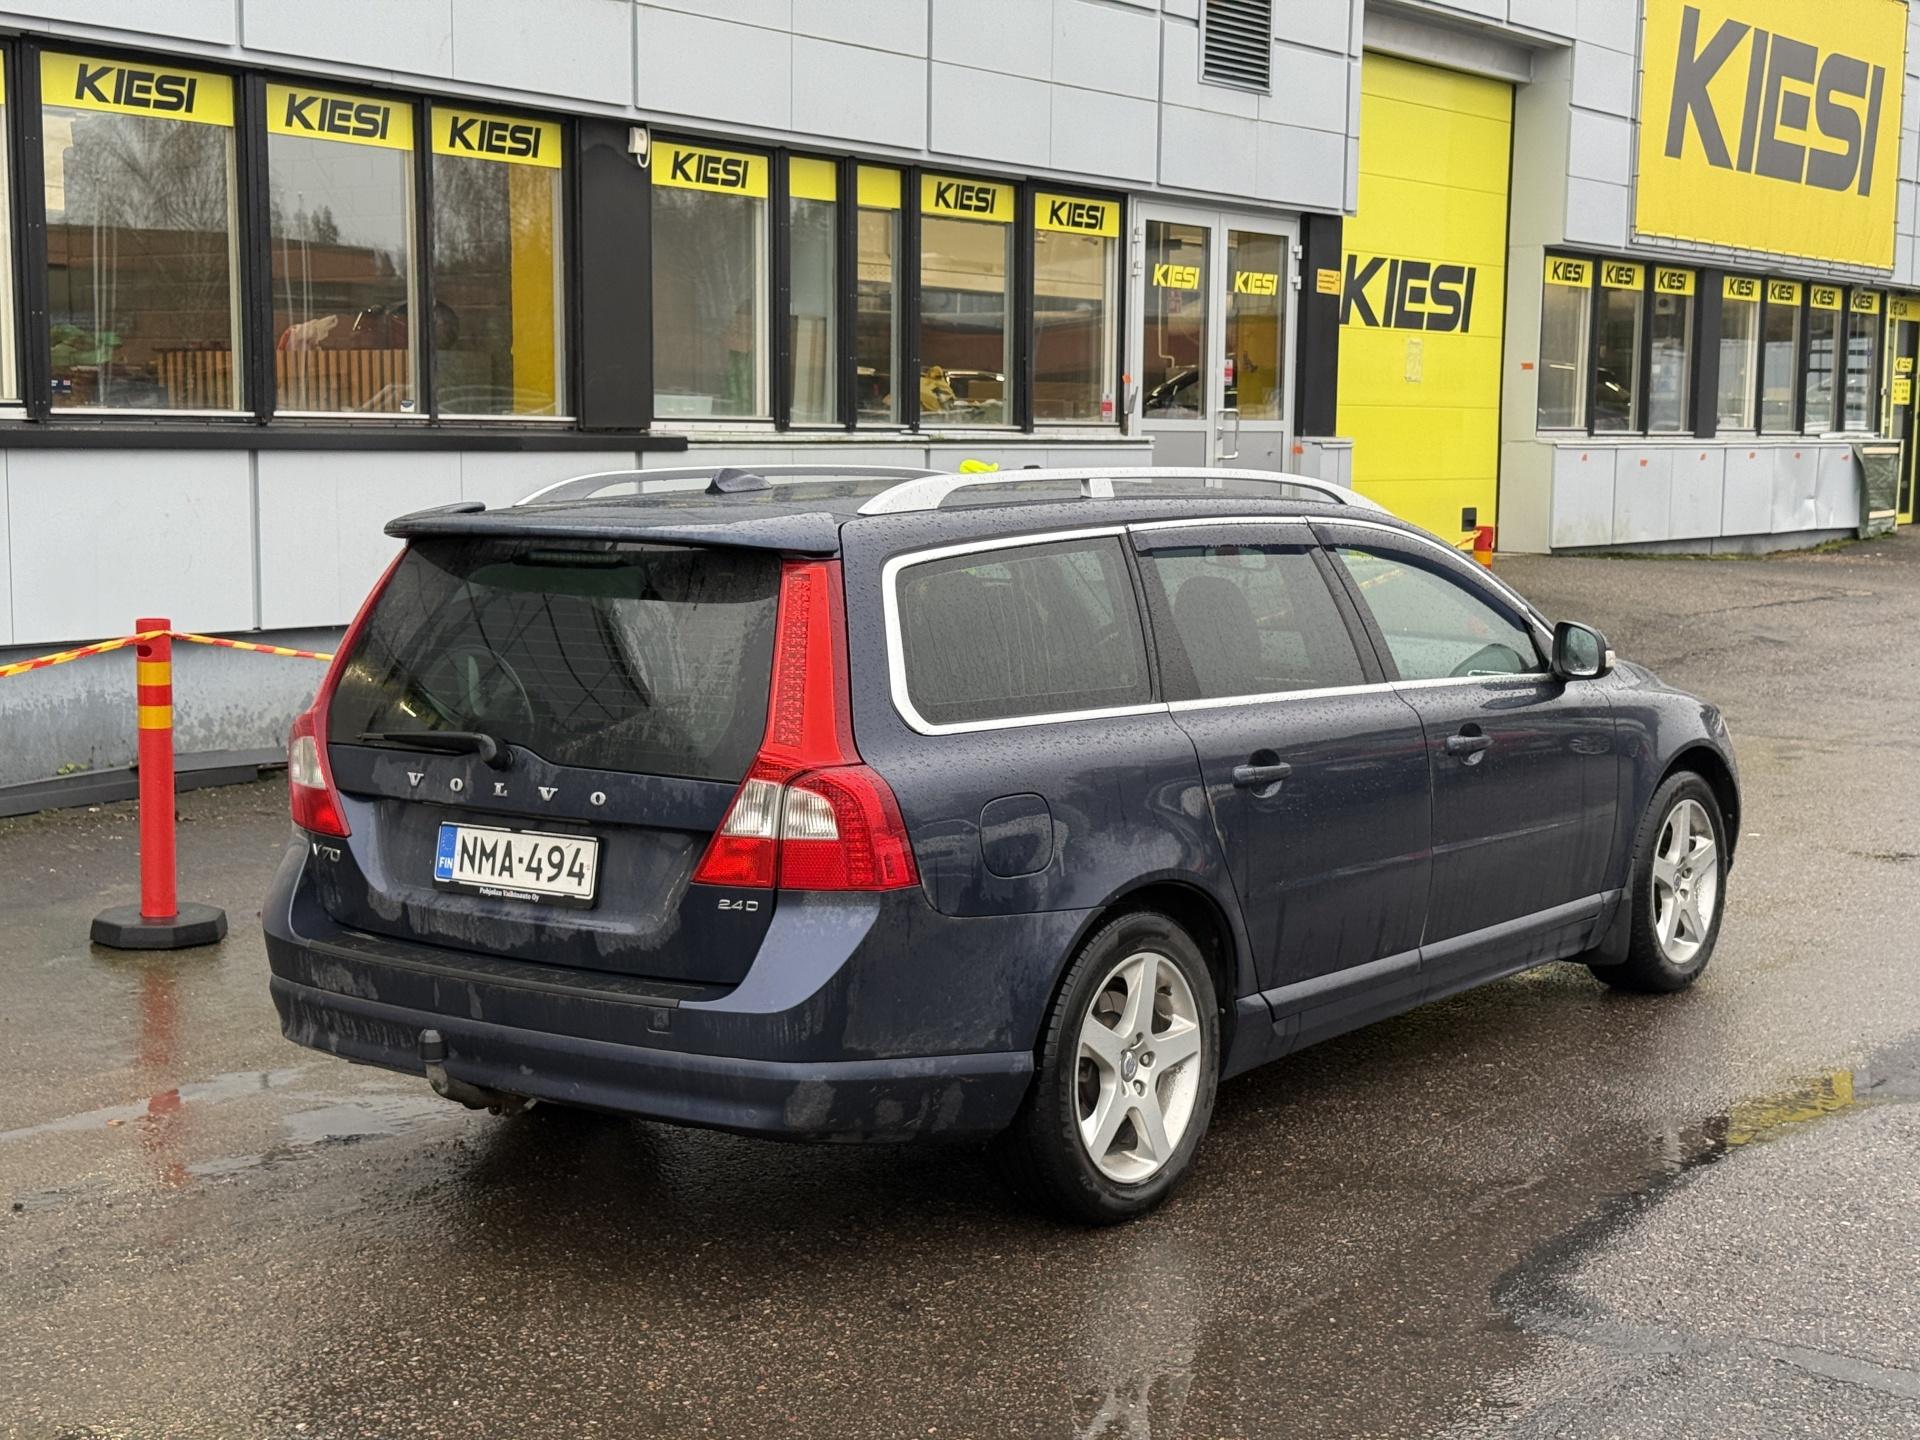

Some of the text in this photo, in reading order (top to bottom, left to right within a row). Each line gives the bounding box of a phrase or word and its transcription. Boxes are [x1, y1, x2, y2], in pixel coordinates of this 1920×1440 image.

[75, 63, 197, 113] KIESI
[1664, 5, 1886, 197] KIESI
[284, 93, 390, 140] KIESI
[449, 116, 541, 158] KIESI
[670, 150, 749, 189] KIESI
[934, 181, 996, 214] KIESI
[1048, 200, 1105, 231] KIESI
[1153, 262, 1200, 290] KIESI
[1234, 271, 1278, 296] KIESI
[1552, 261, 1584, 282] KIESI
[1605, 264, 1635, 285] KIESI
[1657, 270, 1686, 290] KIESI
[1338, 254, 1476, 333] KIESI
[1728, 276, 1754, 296] KIESI
[1770, 282, 1794, 301] KIESI
[1812, 287, 1835, 306] KIESI
[1851, 291, 1873, 310] KIESI
[408, 771, 607, 806] VOLVO
[439, 856, 454, 870] FIN
